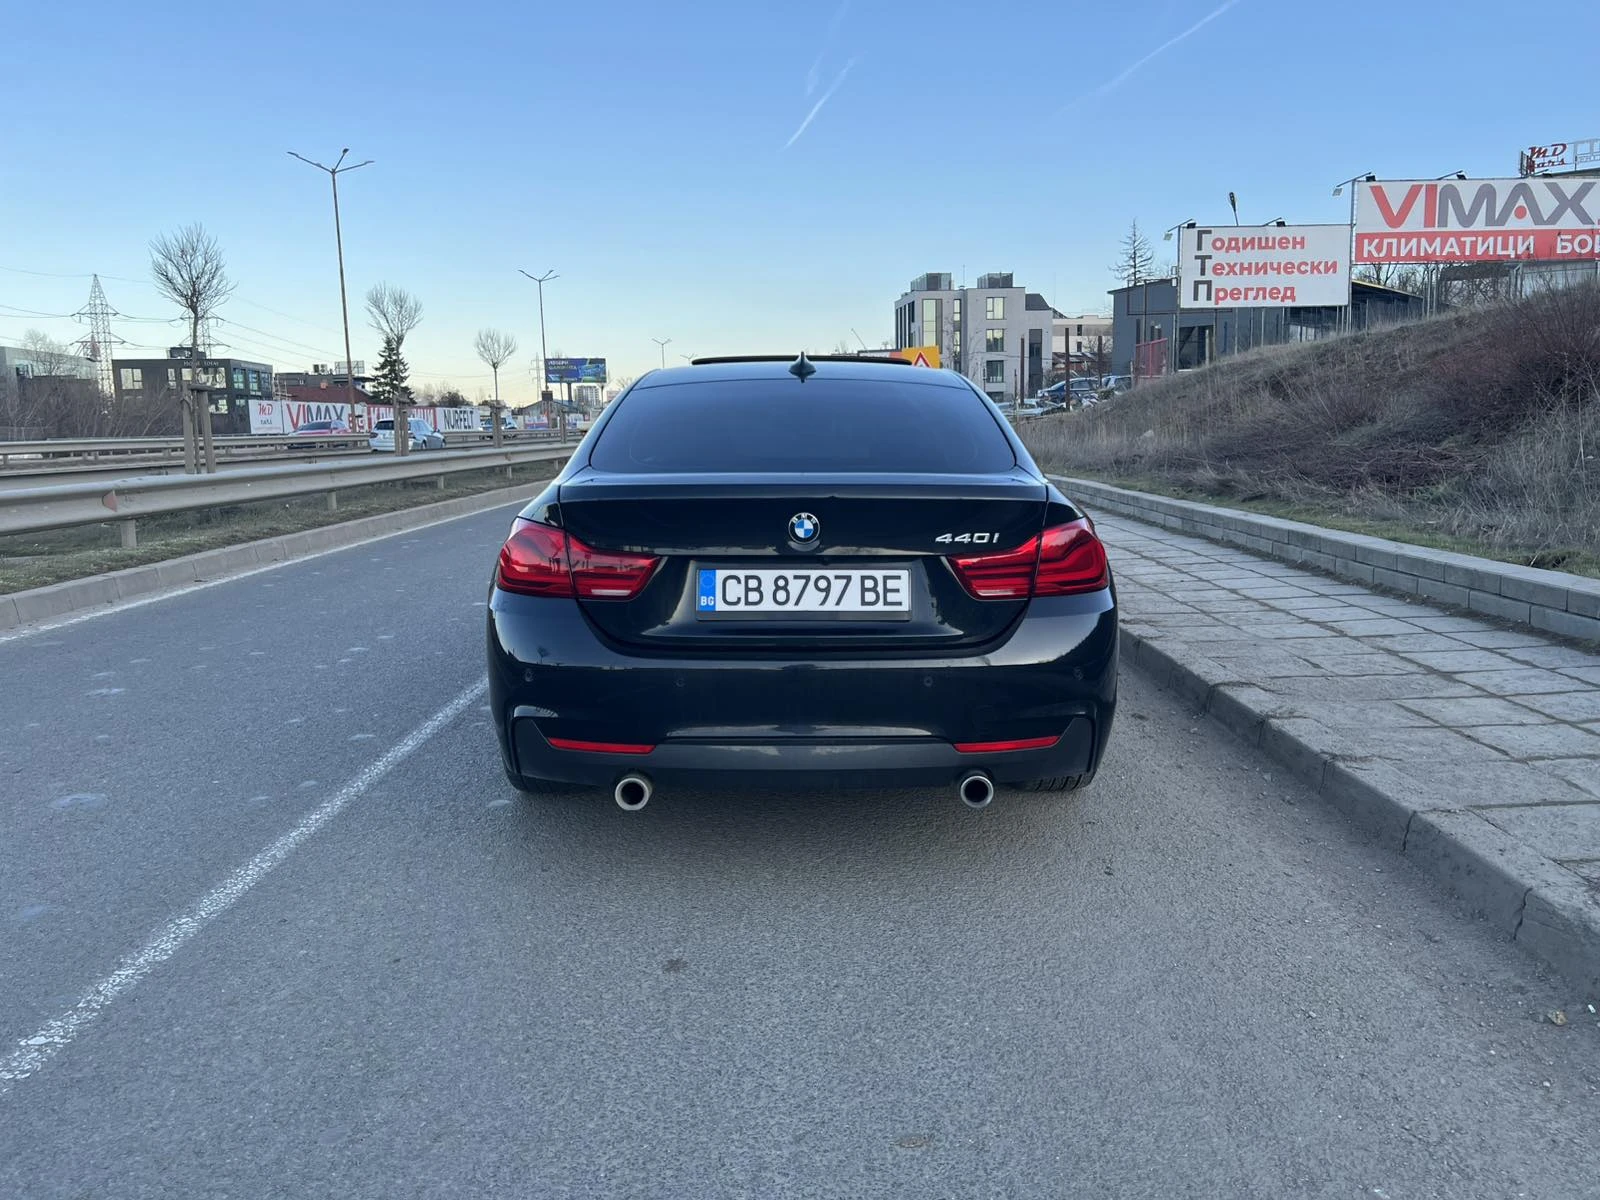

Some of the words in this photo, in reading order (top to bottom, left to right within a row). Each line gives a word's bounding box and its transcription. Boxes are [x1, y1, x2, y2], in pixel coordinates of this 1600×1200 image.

[1369, 181, 1597, 229] VIMAX
[1196, 229, 1305, 253] Годишен
[1363, 235, 1534, 258] КЛИМАТИЦИ
[1194, 254, 1338, 277] Технически
[1193, 279, 1296, 305] Преглед
[286, 403, 345, 431] VIMAX
[791, 512, 818, 525] BMW
[700, 595, 715, 606] BG
[721, 574, 764, 607] CB
[772, 574, 853, 607] 8797
[860, 574, 903, 607] BE
